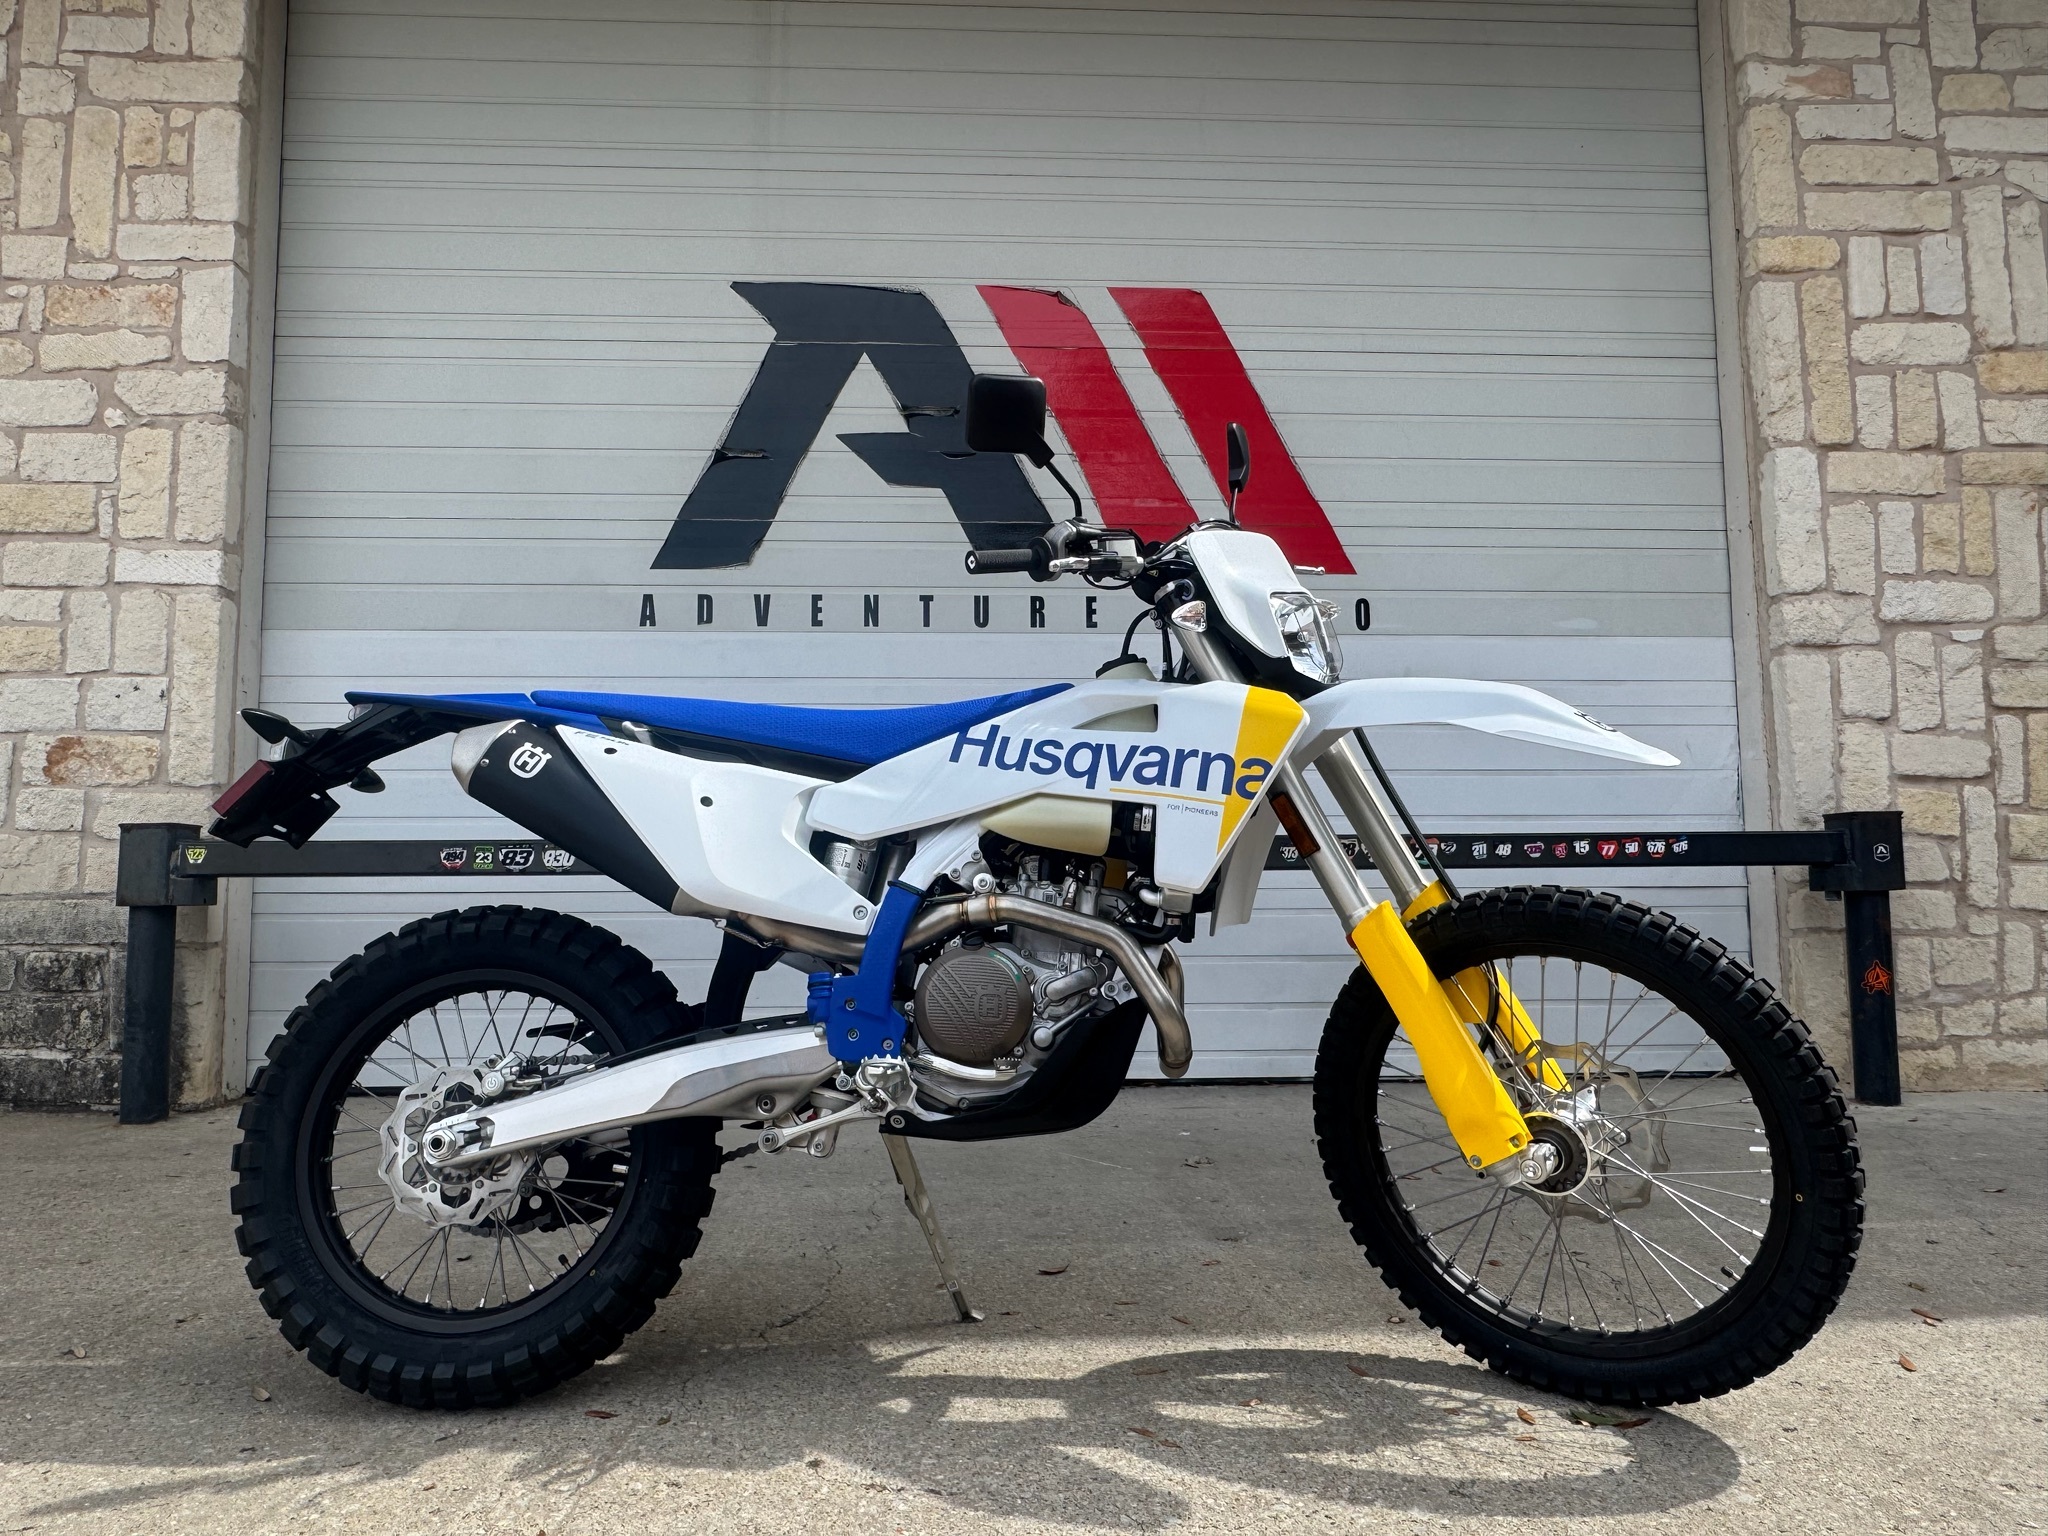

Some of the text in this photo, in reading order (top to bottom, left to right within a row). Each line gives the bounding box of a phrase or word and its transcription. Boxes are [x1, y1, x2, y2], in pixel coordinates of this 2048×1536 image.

[639, 593, 1098, 629] ADVENTURE
[948, 723, 1274, 800] Husqvarna
[1472, 843, 1487, 856] 211
[1495, 844, 1512, 856] 48
[1573, 840, 1590, 854] 15
[1601, 845, 1616, 856] 77
[475, 852, 493, 863] 23
[502, 850, 532, 867] 83
